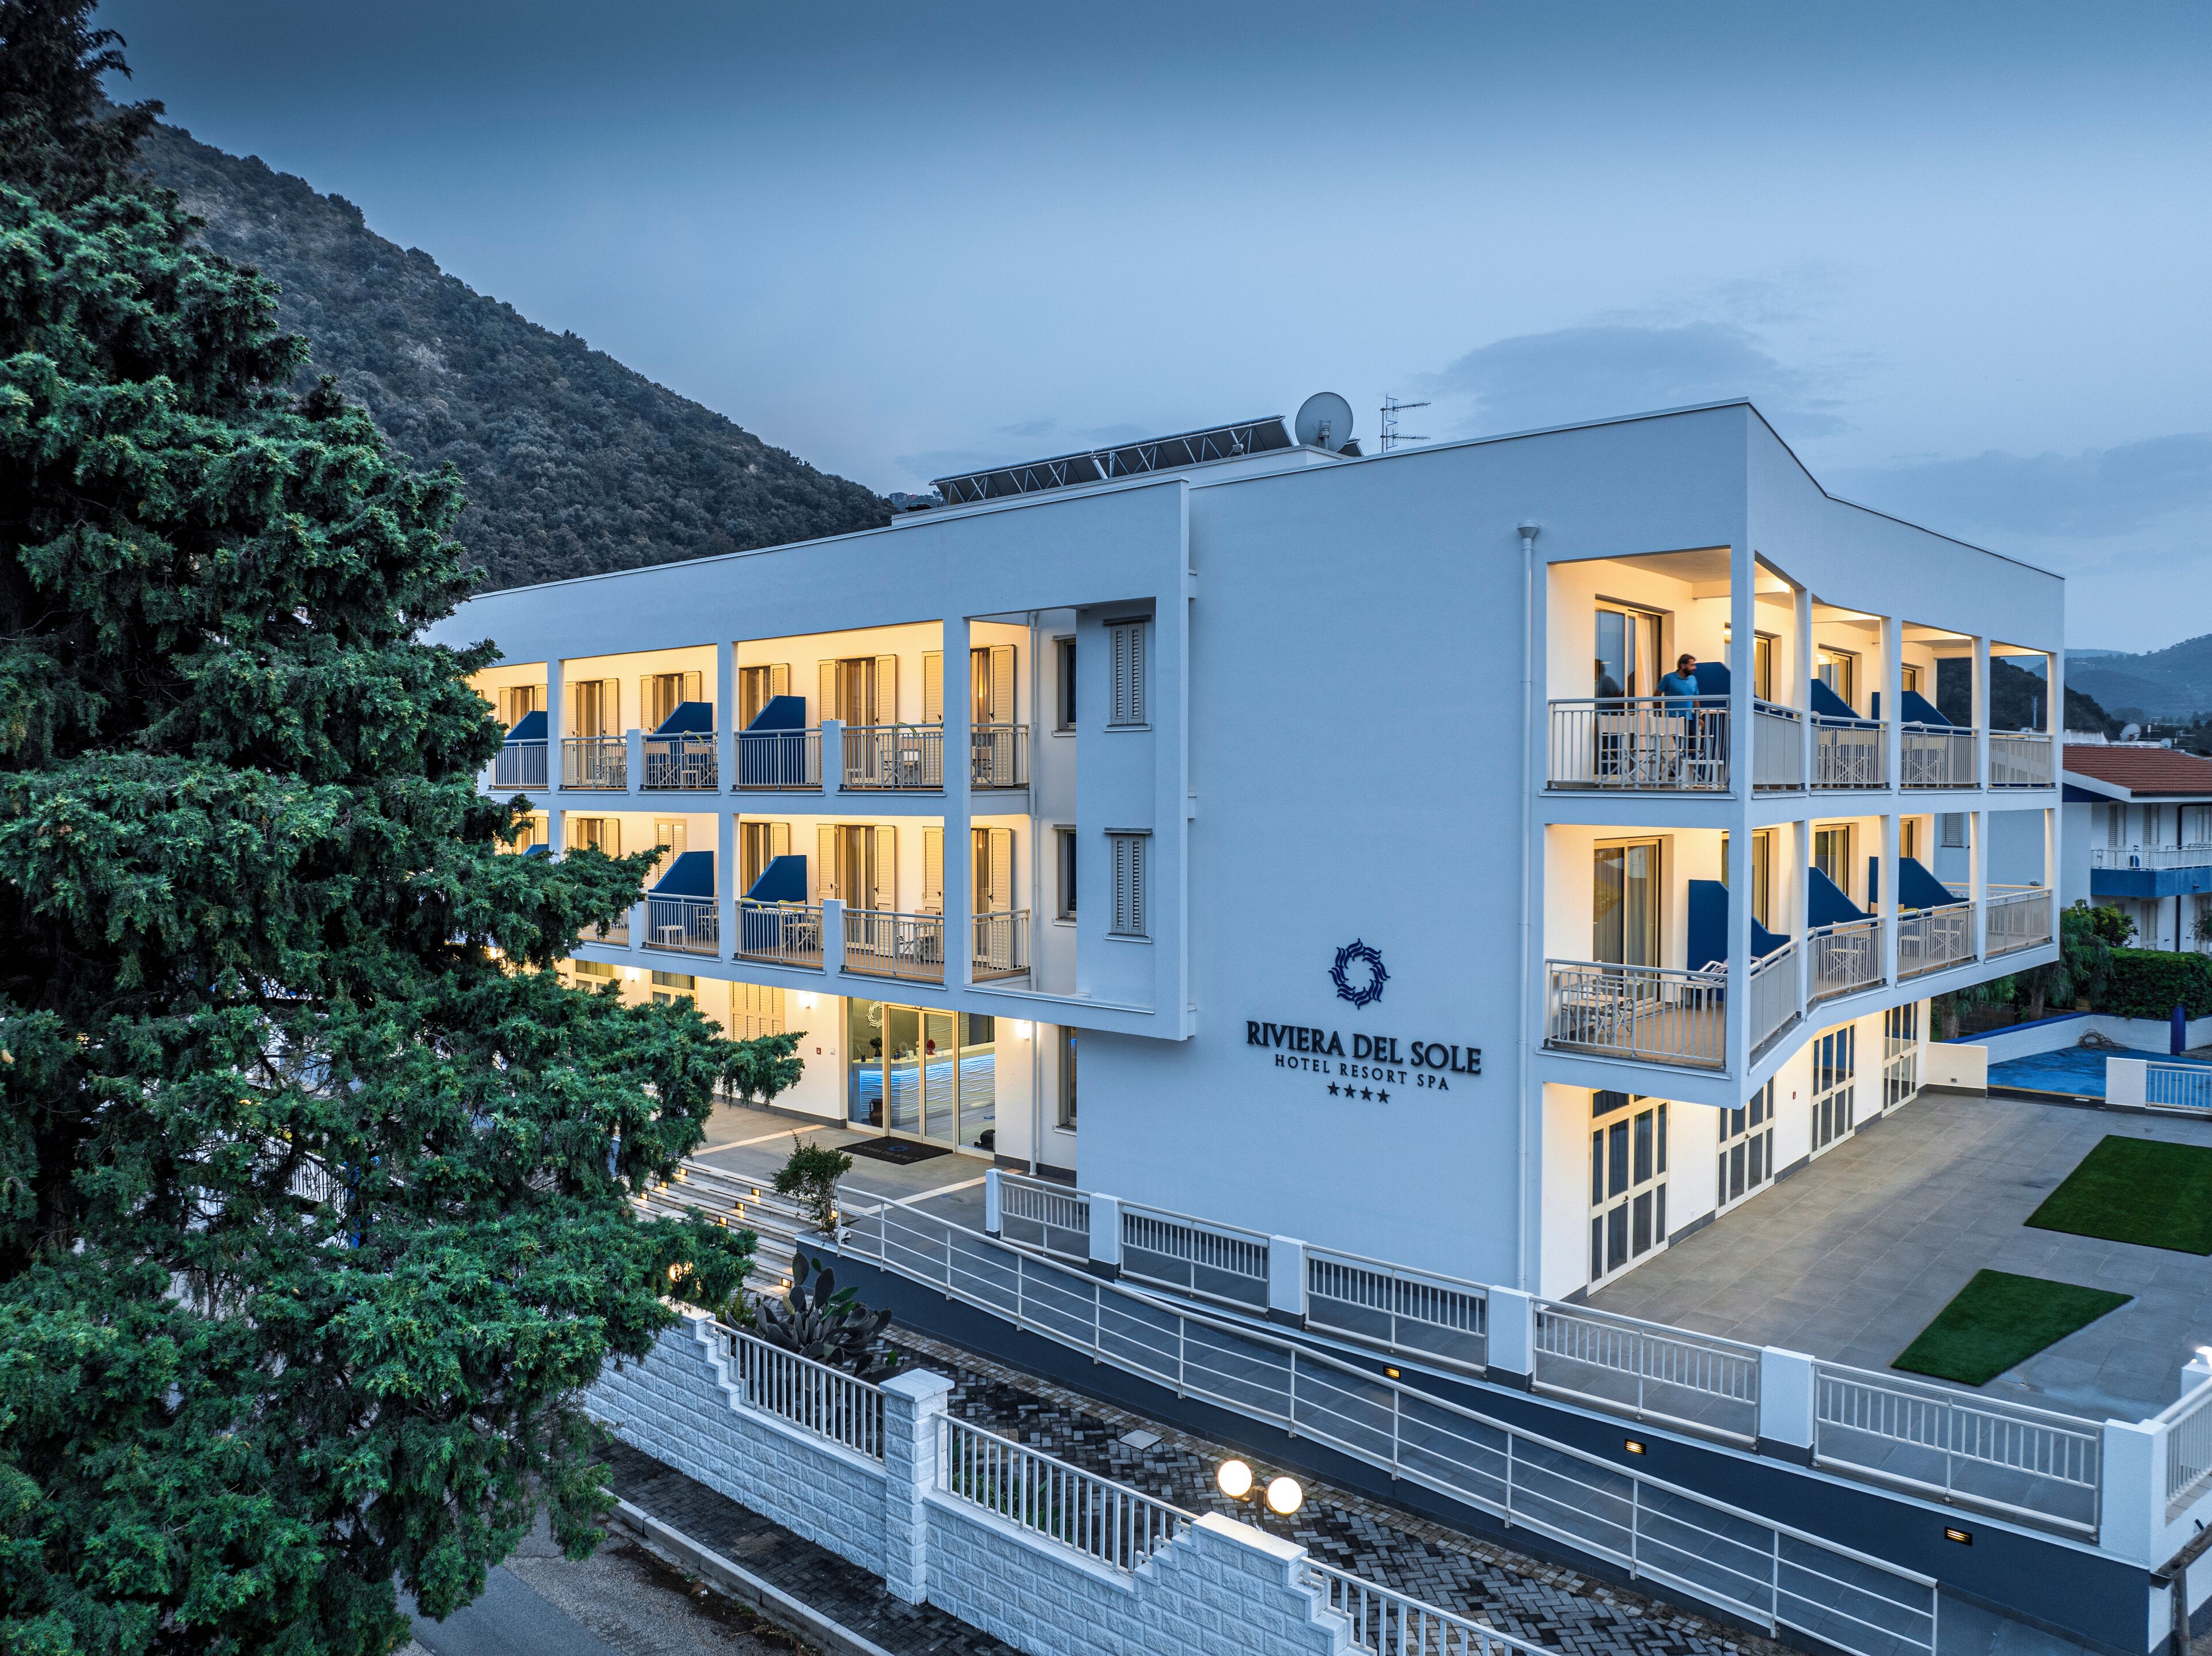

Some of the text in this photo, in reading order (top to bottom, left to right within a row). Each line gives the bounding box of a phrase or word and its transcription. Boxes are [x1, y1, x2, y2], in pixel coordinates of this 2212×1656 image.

[1245, 1020, 1482, 1075] RIVIERA DEL SOLE
[1275, 1054, 1449, 1090] HOTEL RESORT SPA
